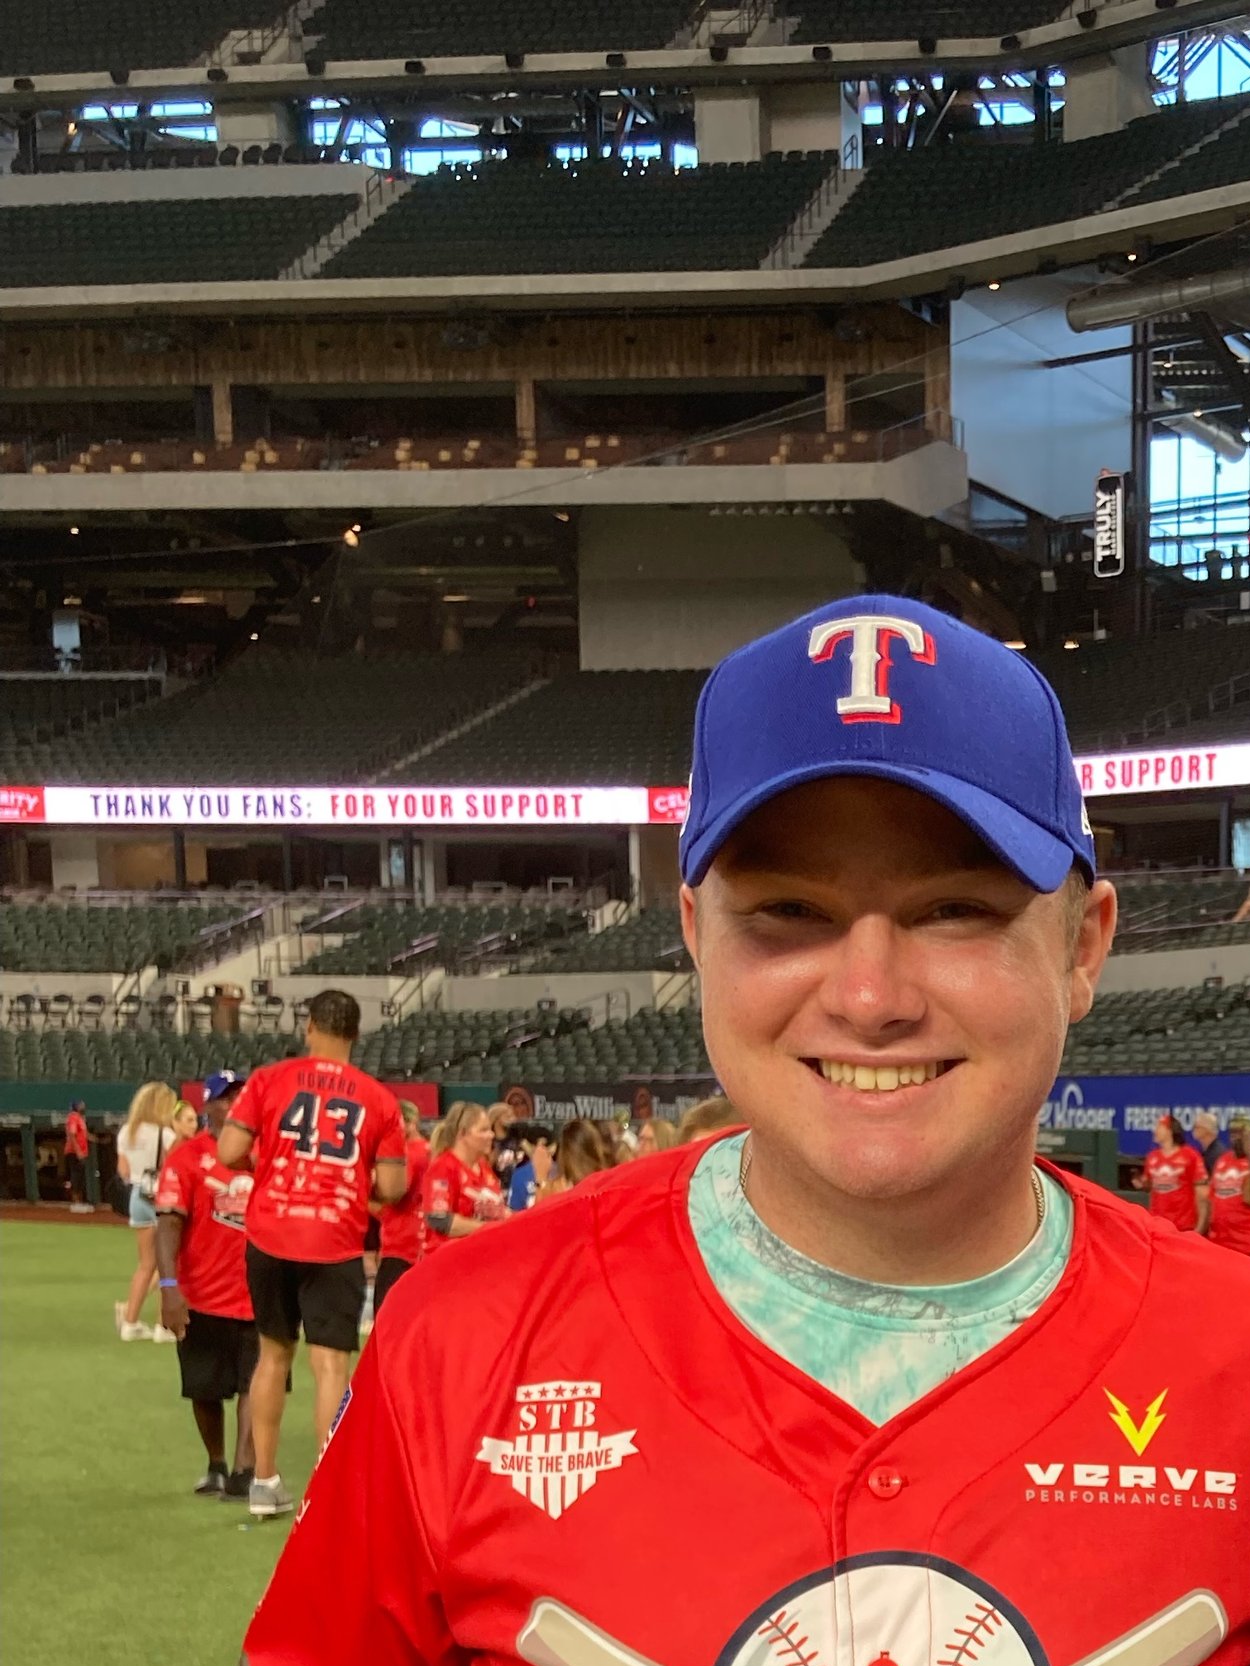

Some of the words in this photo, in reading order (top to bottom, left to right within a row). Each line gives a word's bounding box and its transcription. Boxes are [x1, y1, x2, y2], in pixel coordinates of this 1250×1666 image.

[1096, 492, 1111, 562] TRULY
[808, 616, 937, 725] T
[1105, 753, 1217, 789] SUPPORT
[90, 794, 172, 818] THANK
[183, 794, 231, 818] YOU
[243, 794, 313, 818] FANS:
[330, 794, 375, 818] FOR
[387, 794, 454, 818] YOUR
[465, 794, 583, 818] SUPPORT
[534, 1094, 576, 1120] Evan
[1055, 1084, 1116, 1130] Kroger
[280, 1091, 366, 1167] 43
[519, 1400, 596, 1431] STB
[501, 1454, 533, 1473] SAVE
[538, 1456, 563, 1473] THE
[568, 1448, 613, 1472] BRAVE
[1024, 1463, 1237, 1494] VERVE
[1025, 1489, 1182, 1507] PERFORMANCE
[1192, 1496, 1238, 1511] LABS
